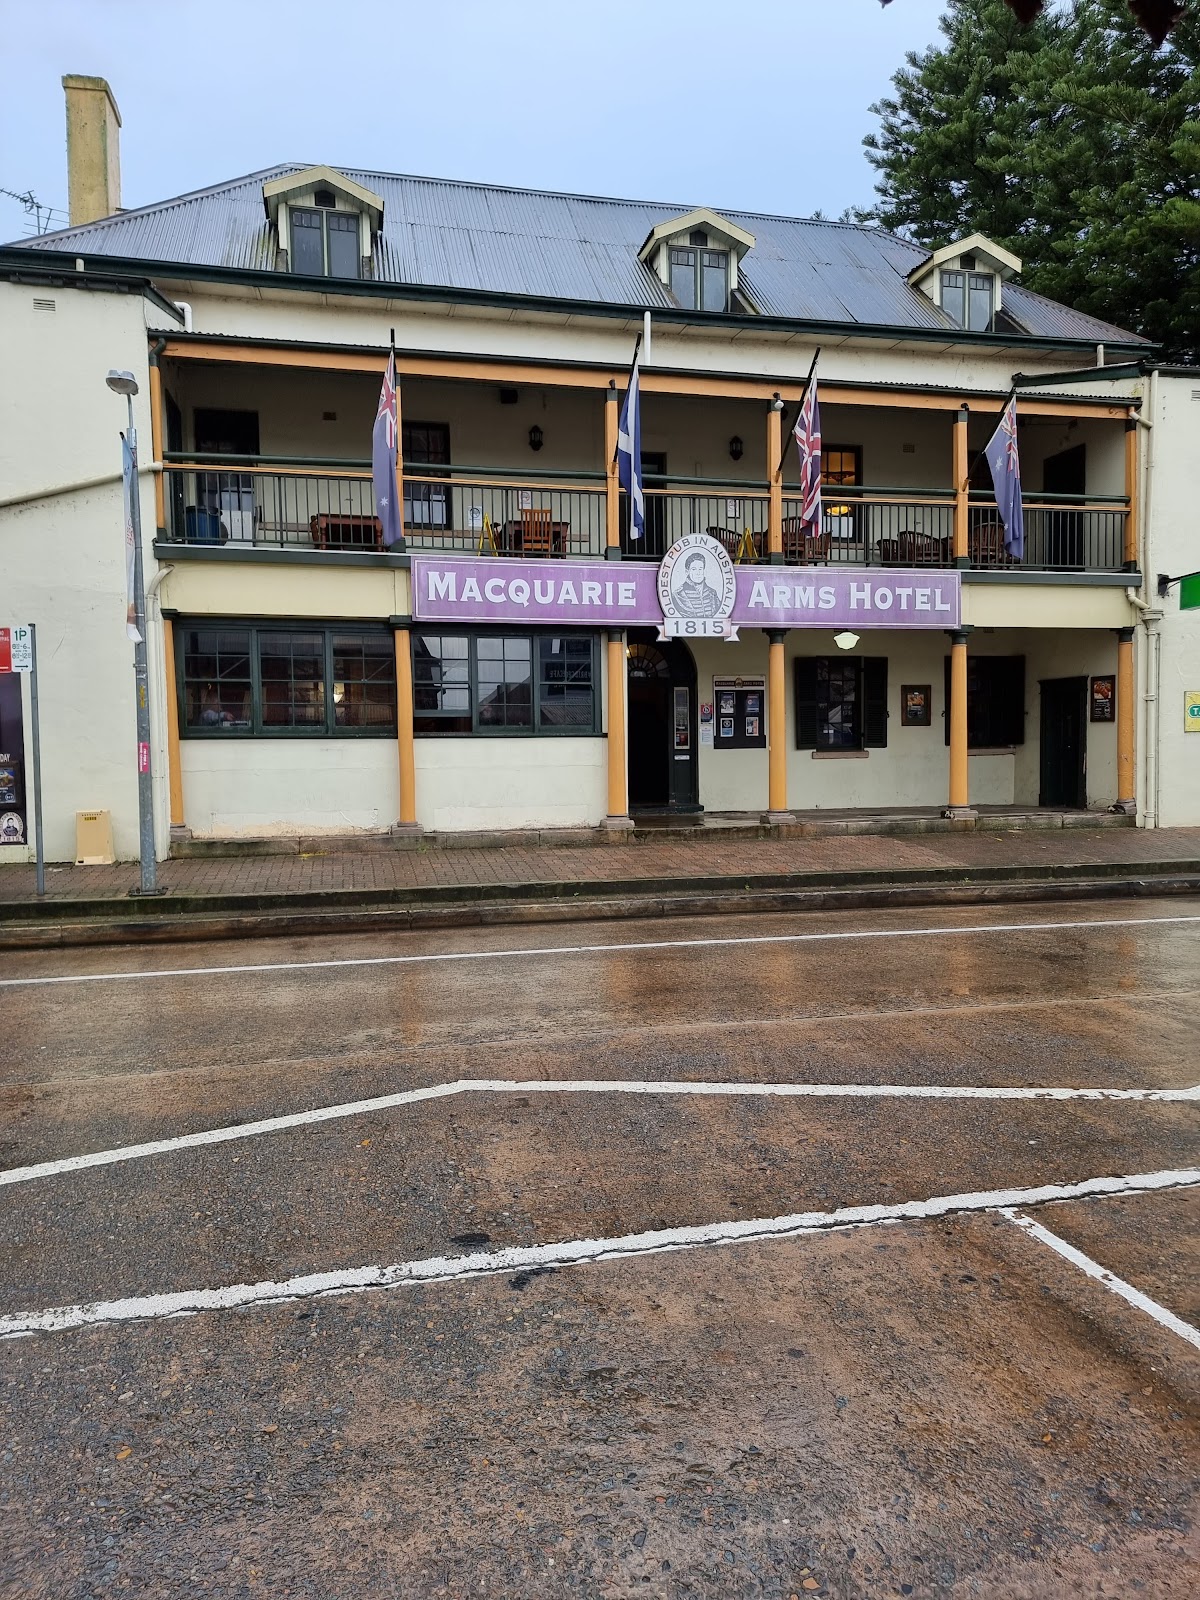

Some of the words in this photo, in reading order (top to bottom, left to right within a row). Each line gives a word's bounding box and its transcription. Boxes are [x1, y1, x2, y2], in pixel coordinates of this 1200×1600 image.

[667, 538, 691, 560] PUB
[694, 536, 709, 546] IN
[427, 571, 637, 608] MACQUARIE
[747, 579, 837, 609] ARMS
[848, 582, 952, 611] HOTEL
[660, 562, 676, 616] OLDEST
[710, 545, 734, 616] AUSTRALIA
[14, 630, 27, 641] 1P
[674, 620, 724, 634] 1815
